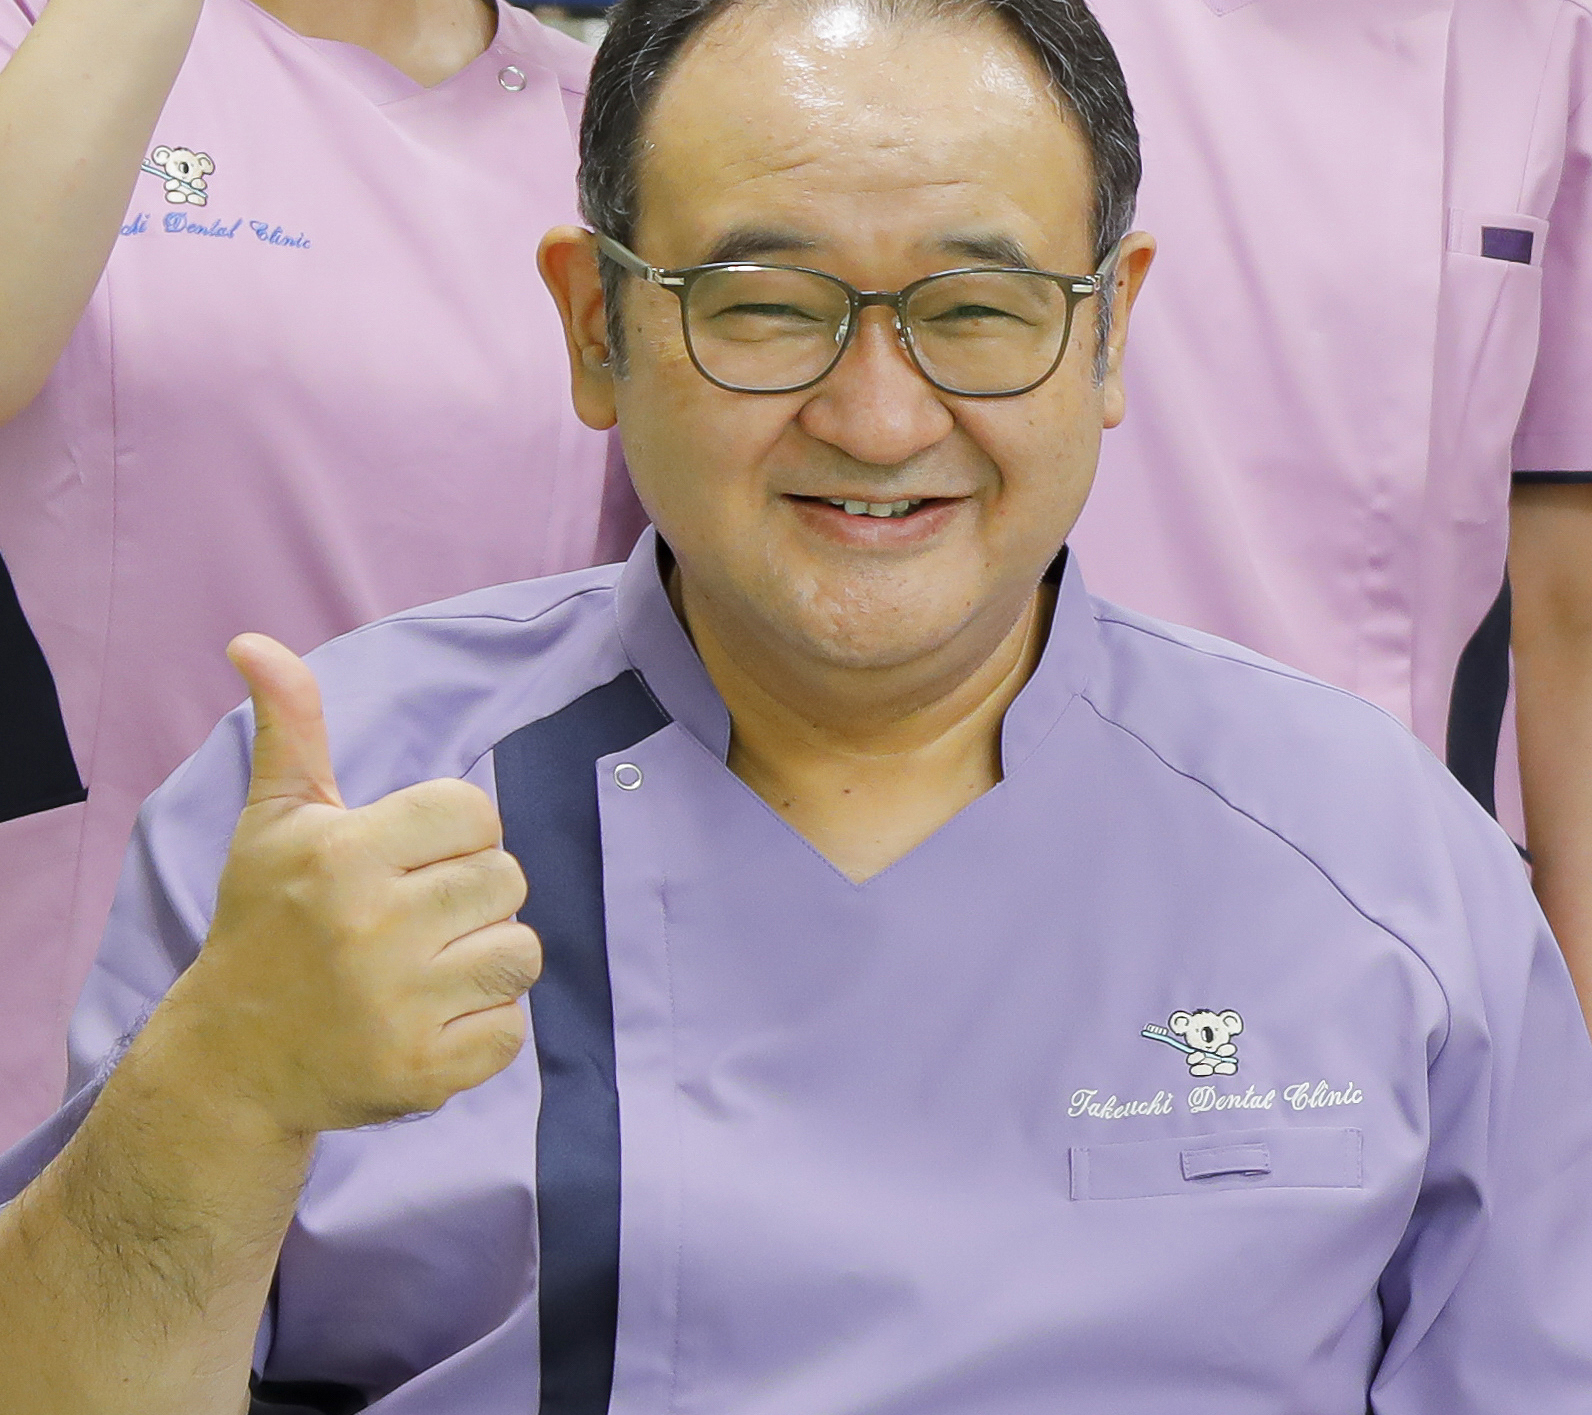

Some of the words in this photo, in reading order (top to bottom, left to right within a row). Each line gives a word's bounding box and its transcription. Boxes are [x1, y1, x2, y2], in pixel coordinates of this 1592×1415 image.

[163, 211, 243, 239] Dental
[249, 219, 312, 250] Clinic
[1067, 1088, 1172, 1120] Takeuchi
[1188, 1083, 1276, 1114] Dental
[1283, 1079, 1364, 1111] Clinic
